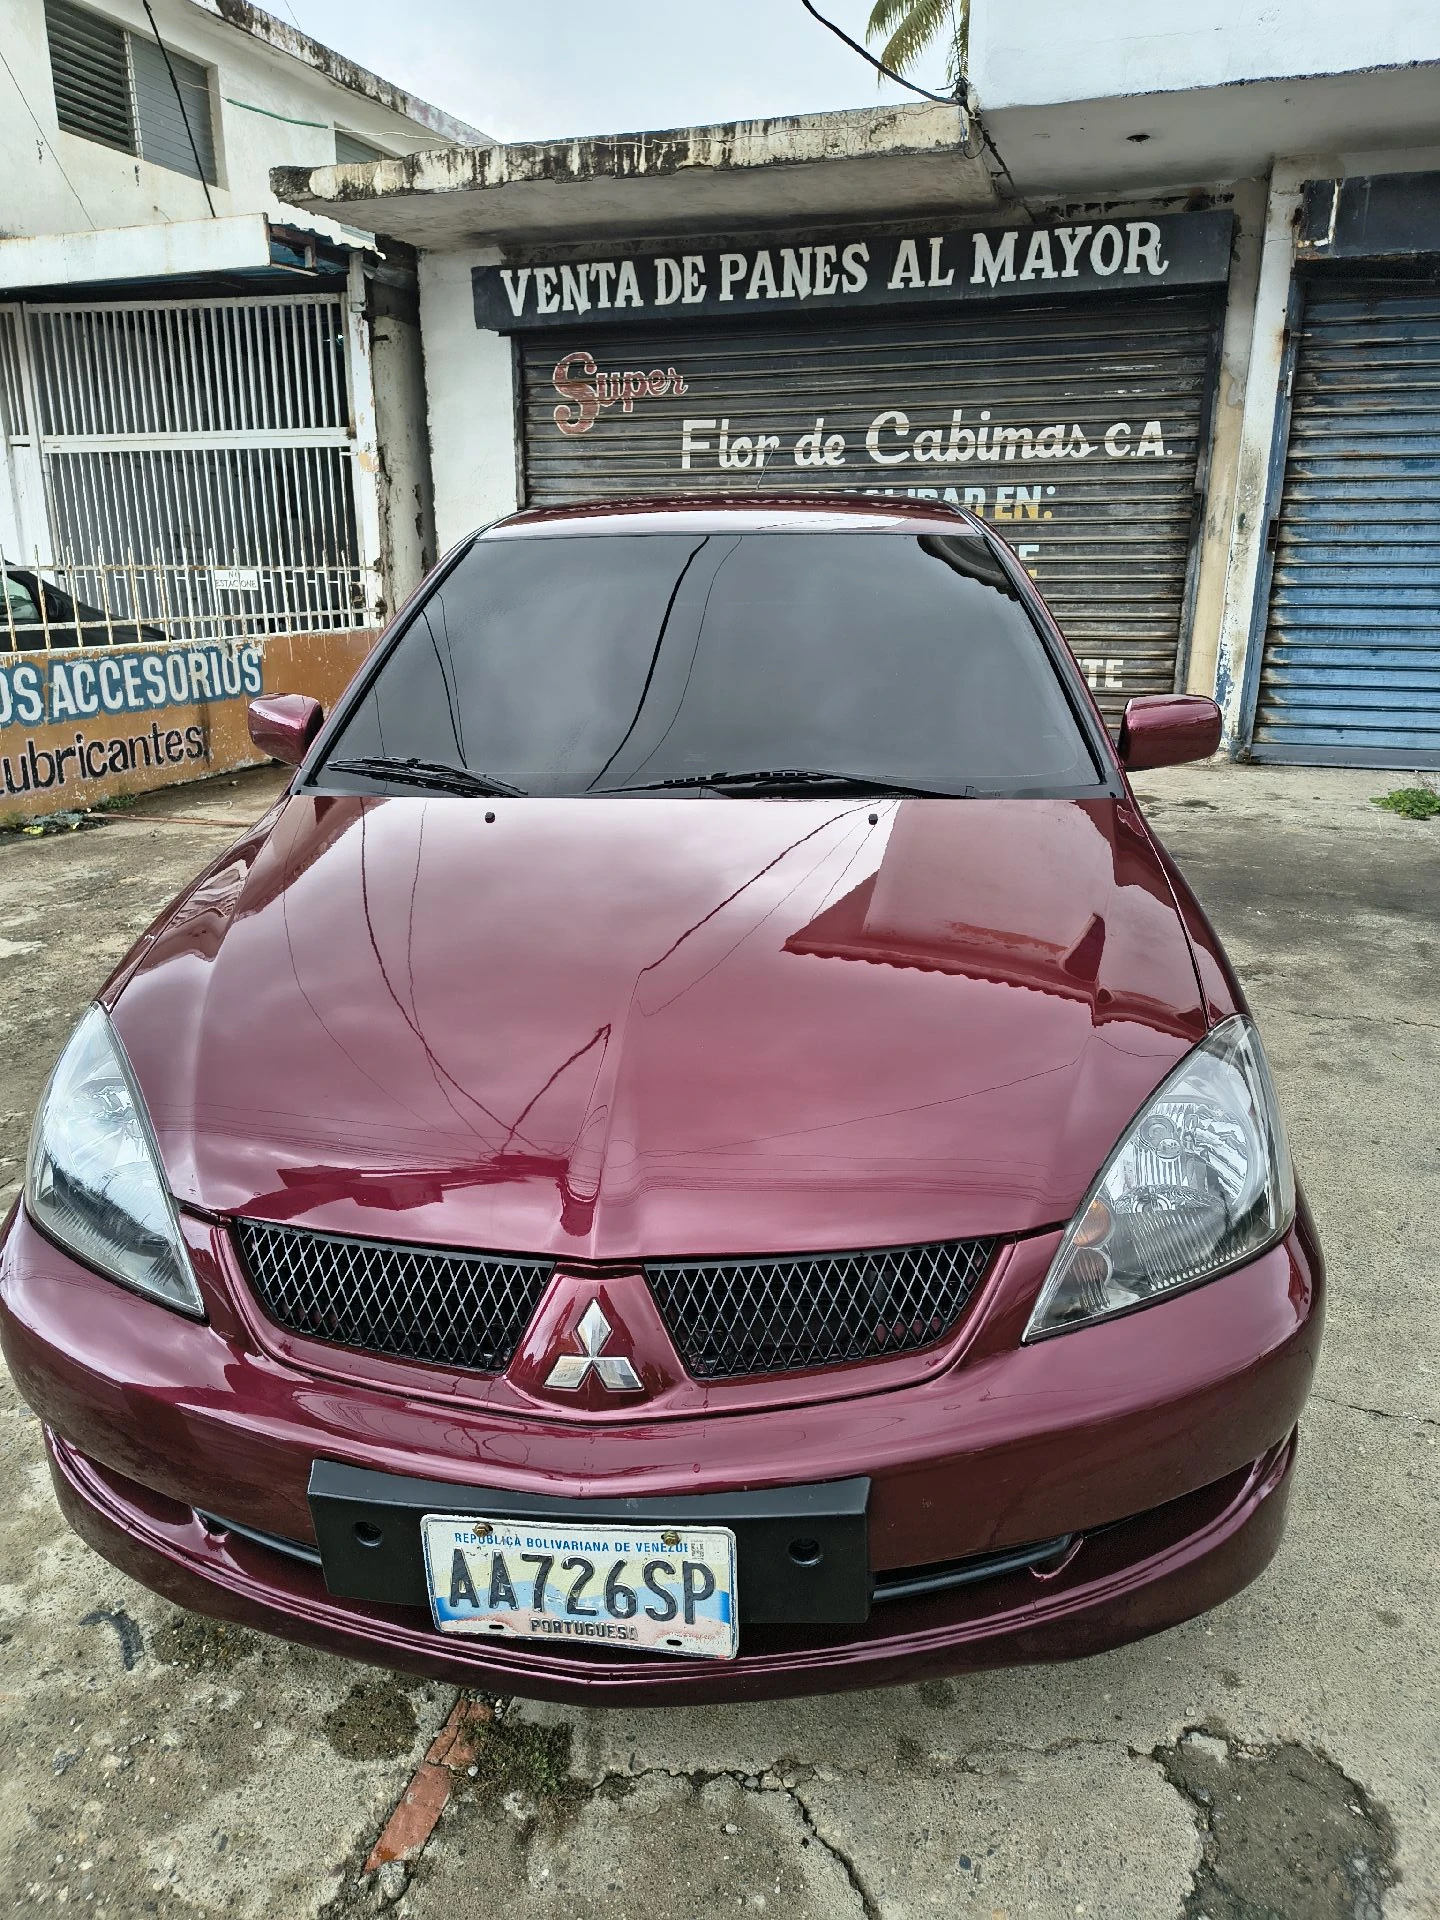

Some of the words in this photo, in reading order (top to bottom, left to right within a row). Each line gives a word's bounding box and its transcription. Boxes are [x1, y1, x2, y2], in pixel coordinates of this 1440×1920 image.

[500, 261, 643, 317] VENTA
[654, 254, 707, 306] DE
[718, 242, 870, 302] PANES
[887, 236, 954, 290] AL
[969, 221, 1169, 288] MAYOR
[552, 351, 689, 435] Super
[681, 418, 780, 470] Flor
[793, 417, 846, 467] de
[865, 409, 1098, 464] Cabimas
[1104, 420, 1173, 457] C.A.
[215, 579, 257, 588] ESTACONE
[52, 649, 261, 718] ACCESORIOS
[0, 722, 204, 794] ubricantes
[526, 1537, 609, 1552] BOLIVARIANA
[615, 1541, 631, 1552] DE
[448, 1547, 716, 1625] AA726SP
[530, 1617, 639, 1640] PORTUGUESA
